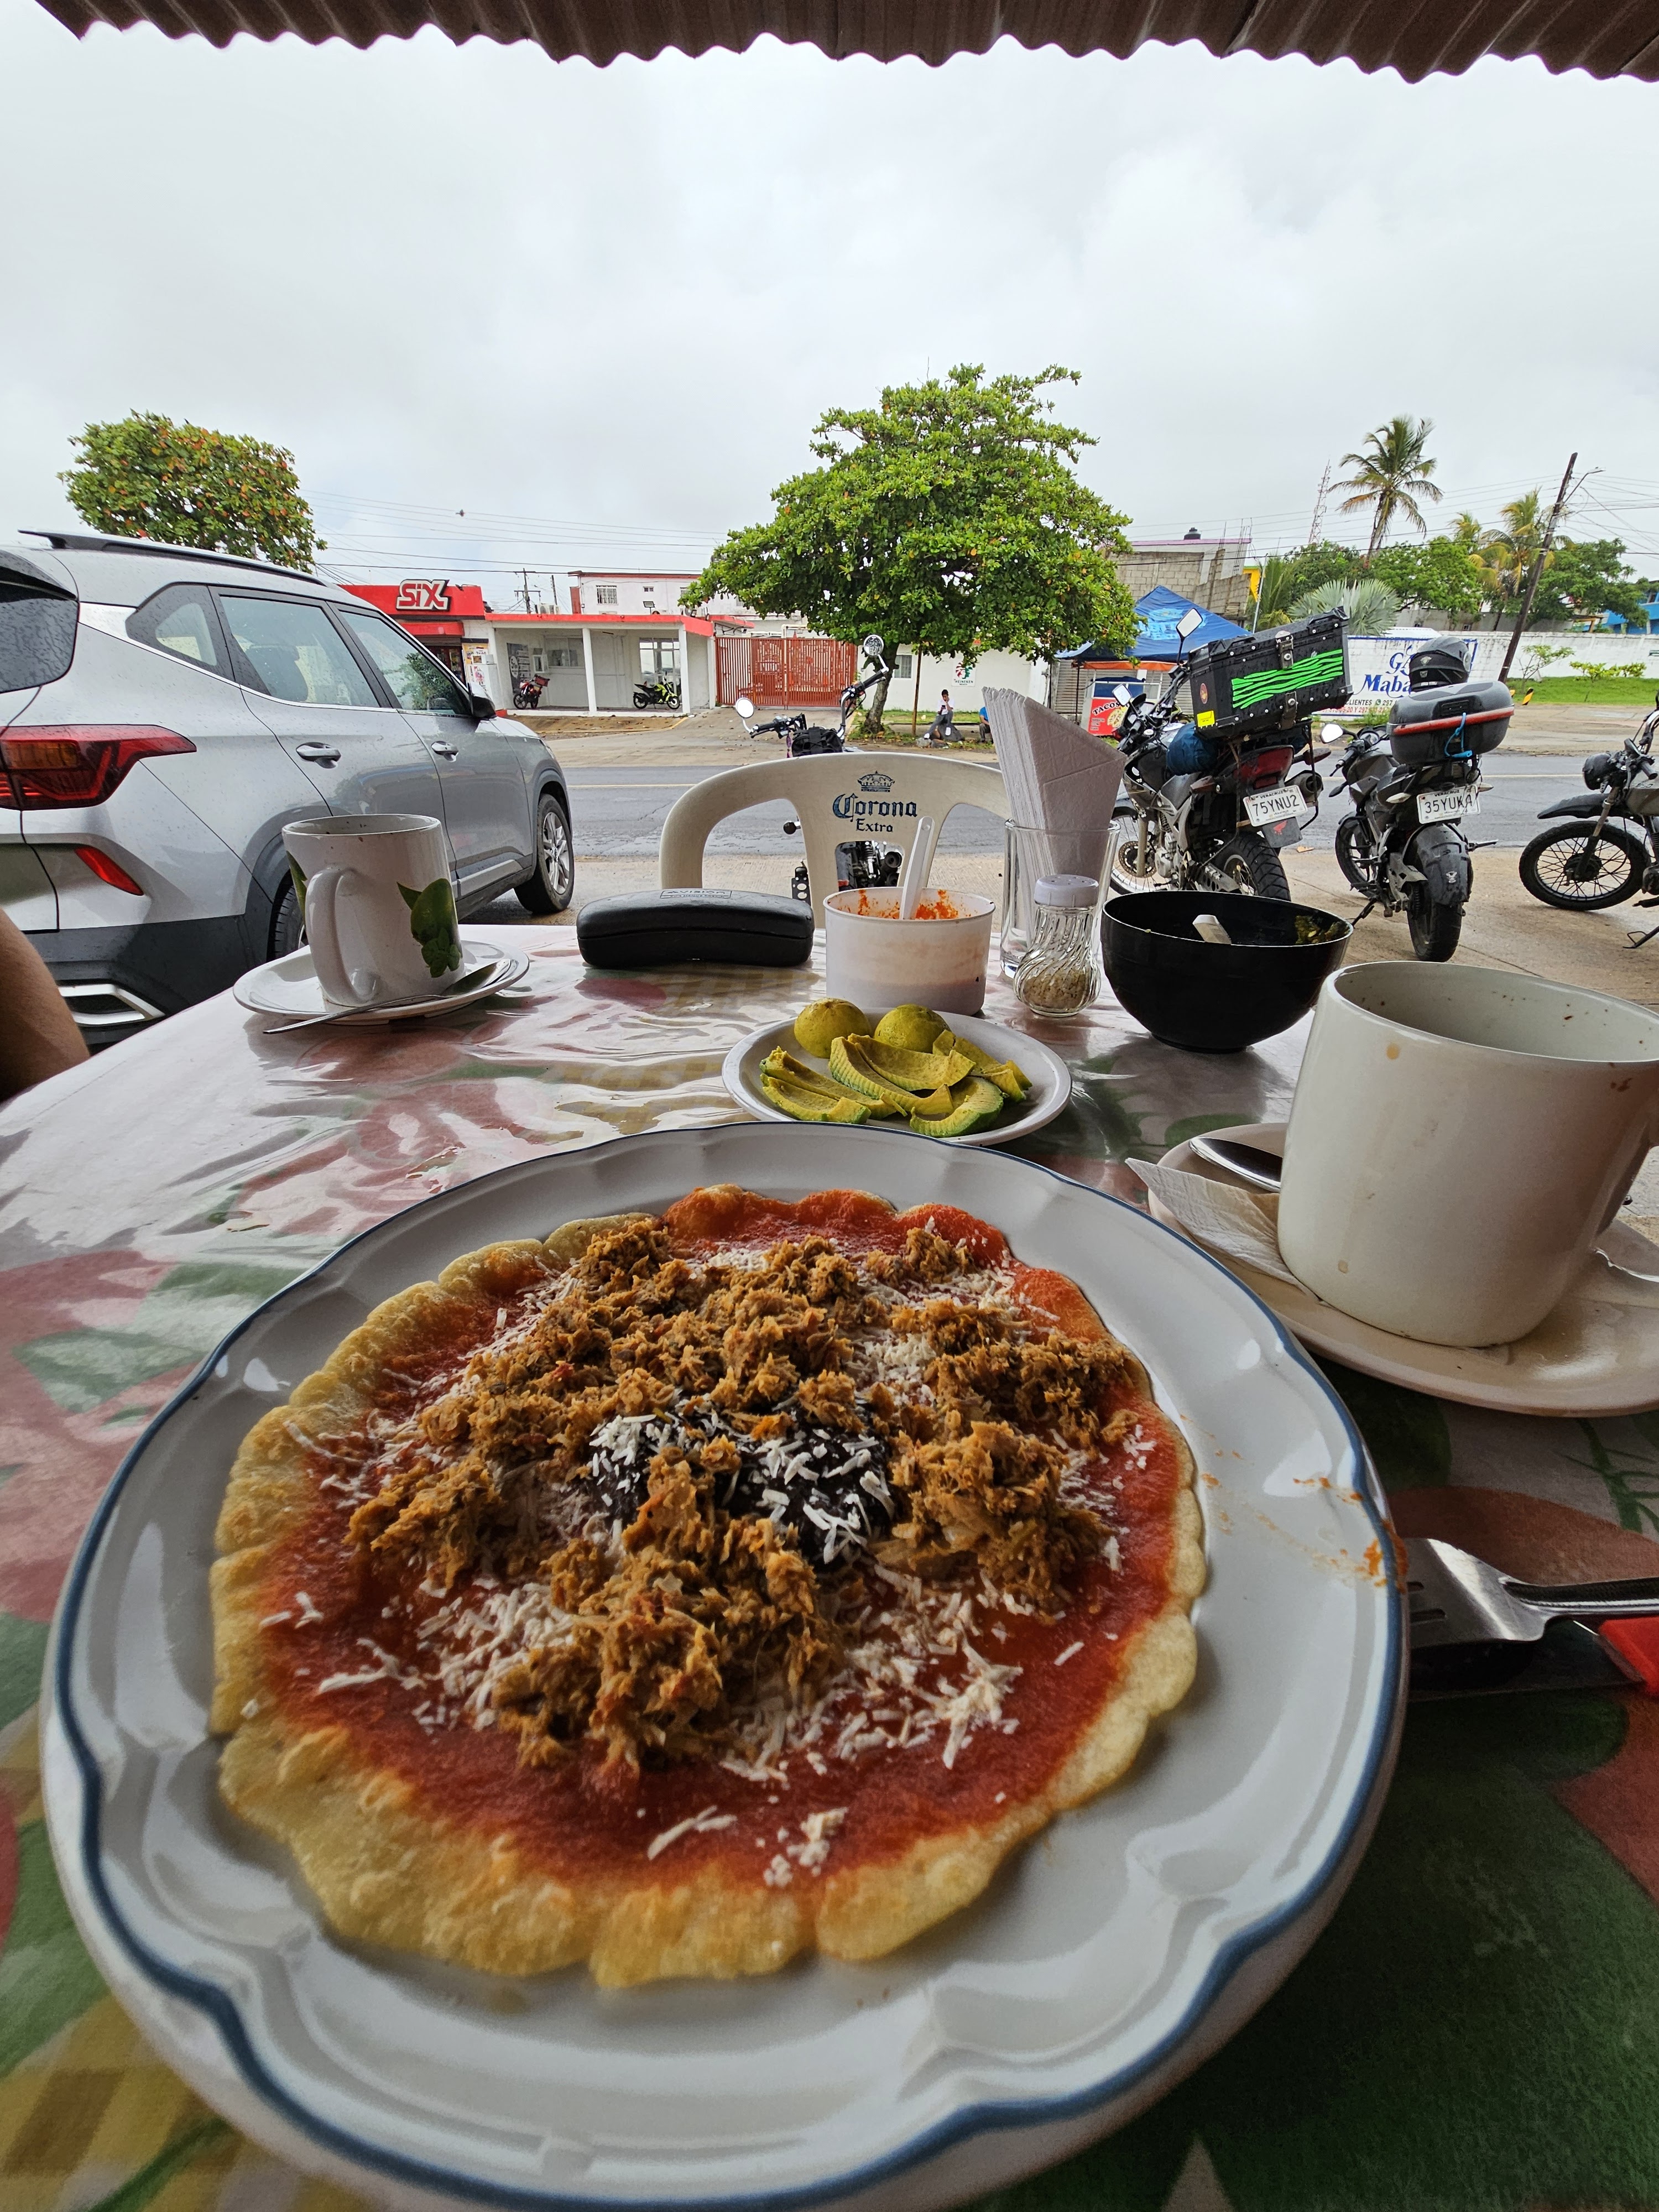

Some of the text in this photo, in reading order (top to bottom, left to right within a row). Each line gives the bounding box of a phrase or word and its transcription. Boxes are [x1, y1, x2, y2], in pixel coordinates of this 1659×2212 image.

[1093, 701, 1120, 715] TACOS
[1260, 790, 1284, 799] VERACRUZ
[832, 792, 918, 823] Corona
[1252, 794, 1300, 816] 75YNU2
[856, 818, 894, 832] Extra
